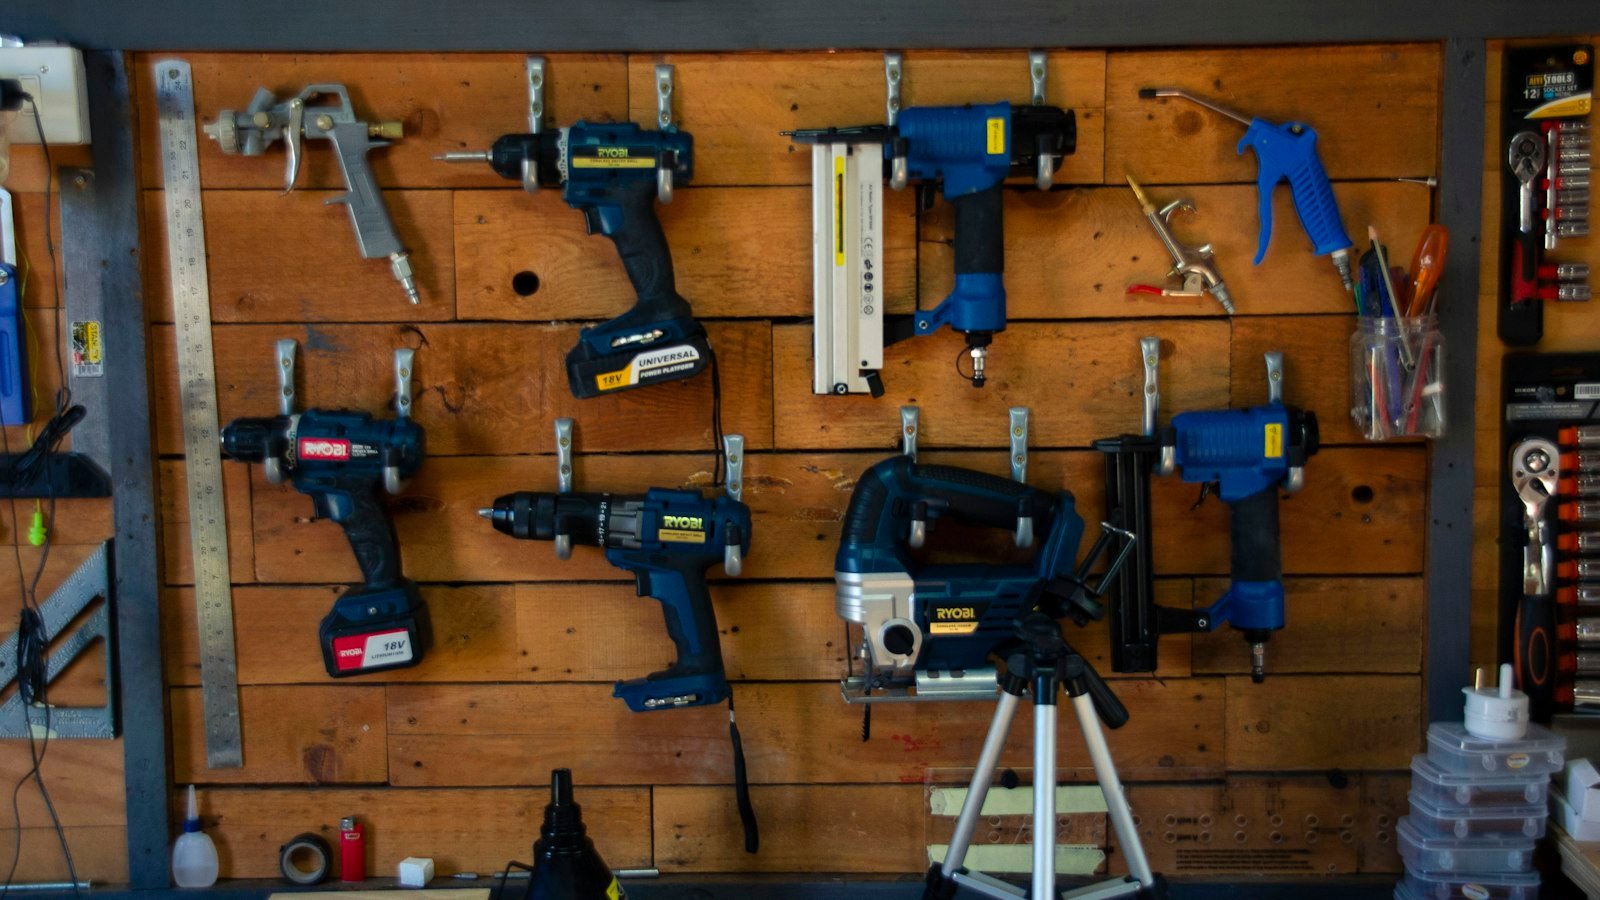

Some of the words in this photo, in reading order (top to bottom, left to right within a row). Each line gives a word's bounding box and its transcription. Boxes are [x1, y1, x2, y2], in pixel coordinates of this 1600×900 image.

[1547, 74, 1572, 84] TOOLS
[597, 148, 628, 157] RYOBI
[603, 374, 622, 384] 18V
[640, 350, 695, 367] UNIVERSAL
[640, 369, 661, 378] POWER
[662, 362, 694, 374] PLATFORM
[304, 442, 346, 456] RYOBI
[663, 515, 703, 529] RYOBI
[936, 607, 974, 619] RYOBI
[384, 640, 406, 651] 18V
[340, 647, 362, 657] RYOBI
